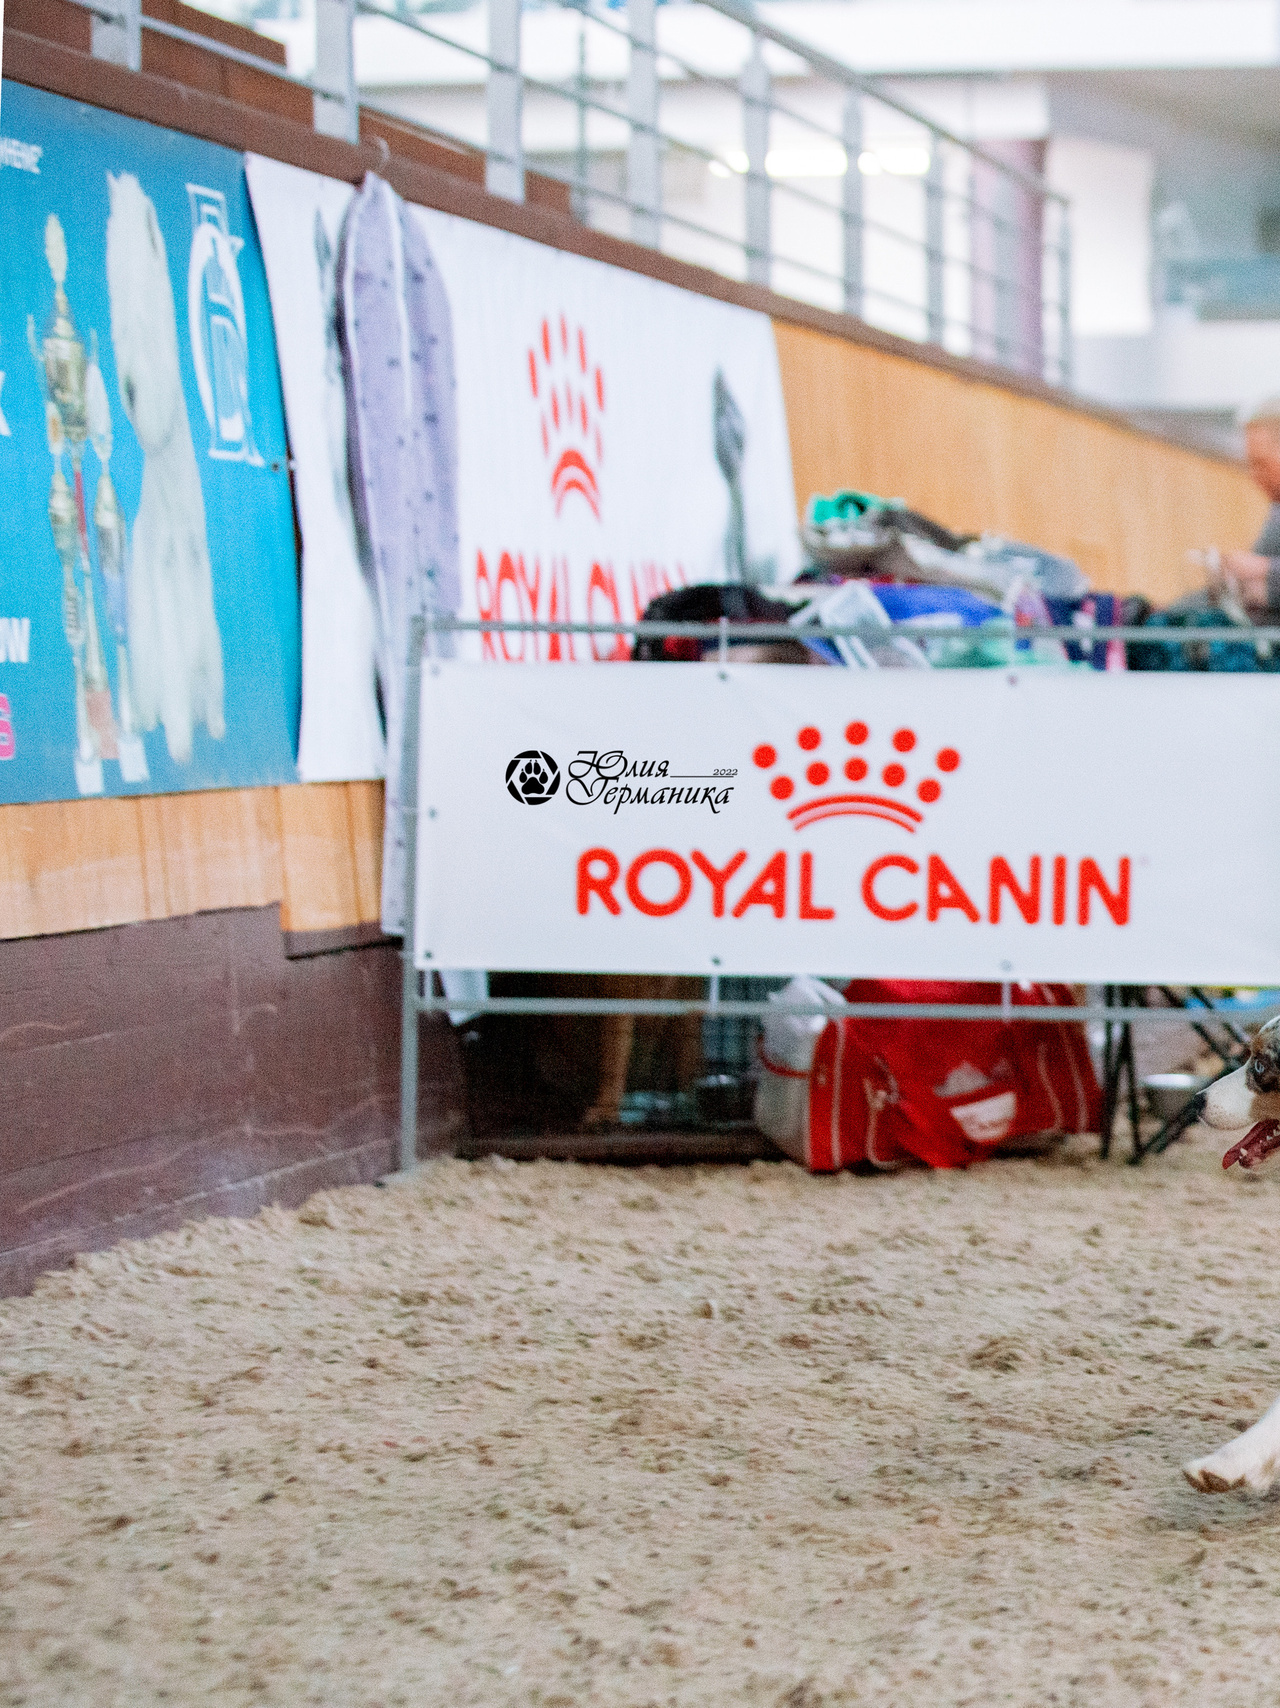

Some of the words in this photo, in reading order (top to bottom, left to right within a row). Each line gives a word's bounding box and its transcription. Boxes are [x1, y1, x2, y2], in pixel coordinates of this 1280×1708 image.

[475, 547, 577, 661] ROYAL
[576, 847, 836, 921] ROYAL
[861, 854, 1131, 926] CANIN
